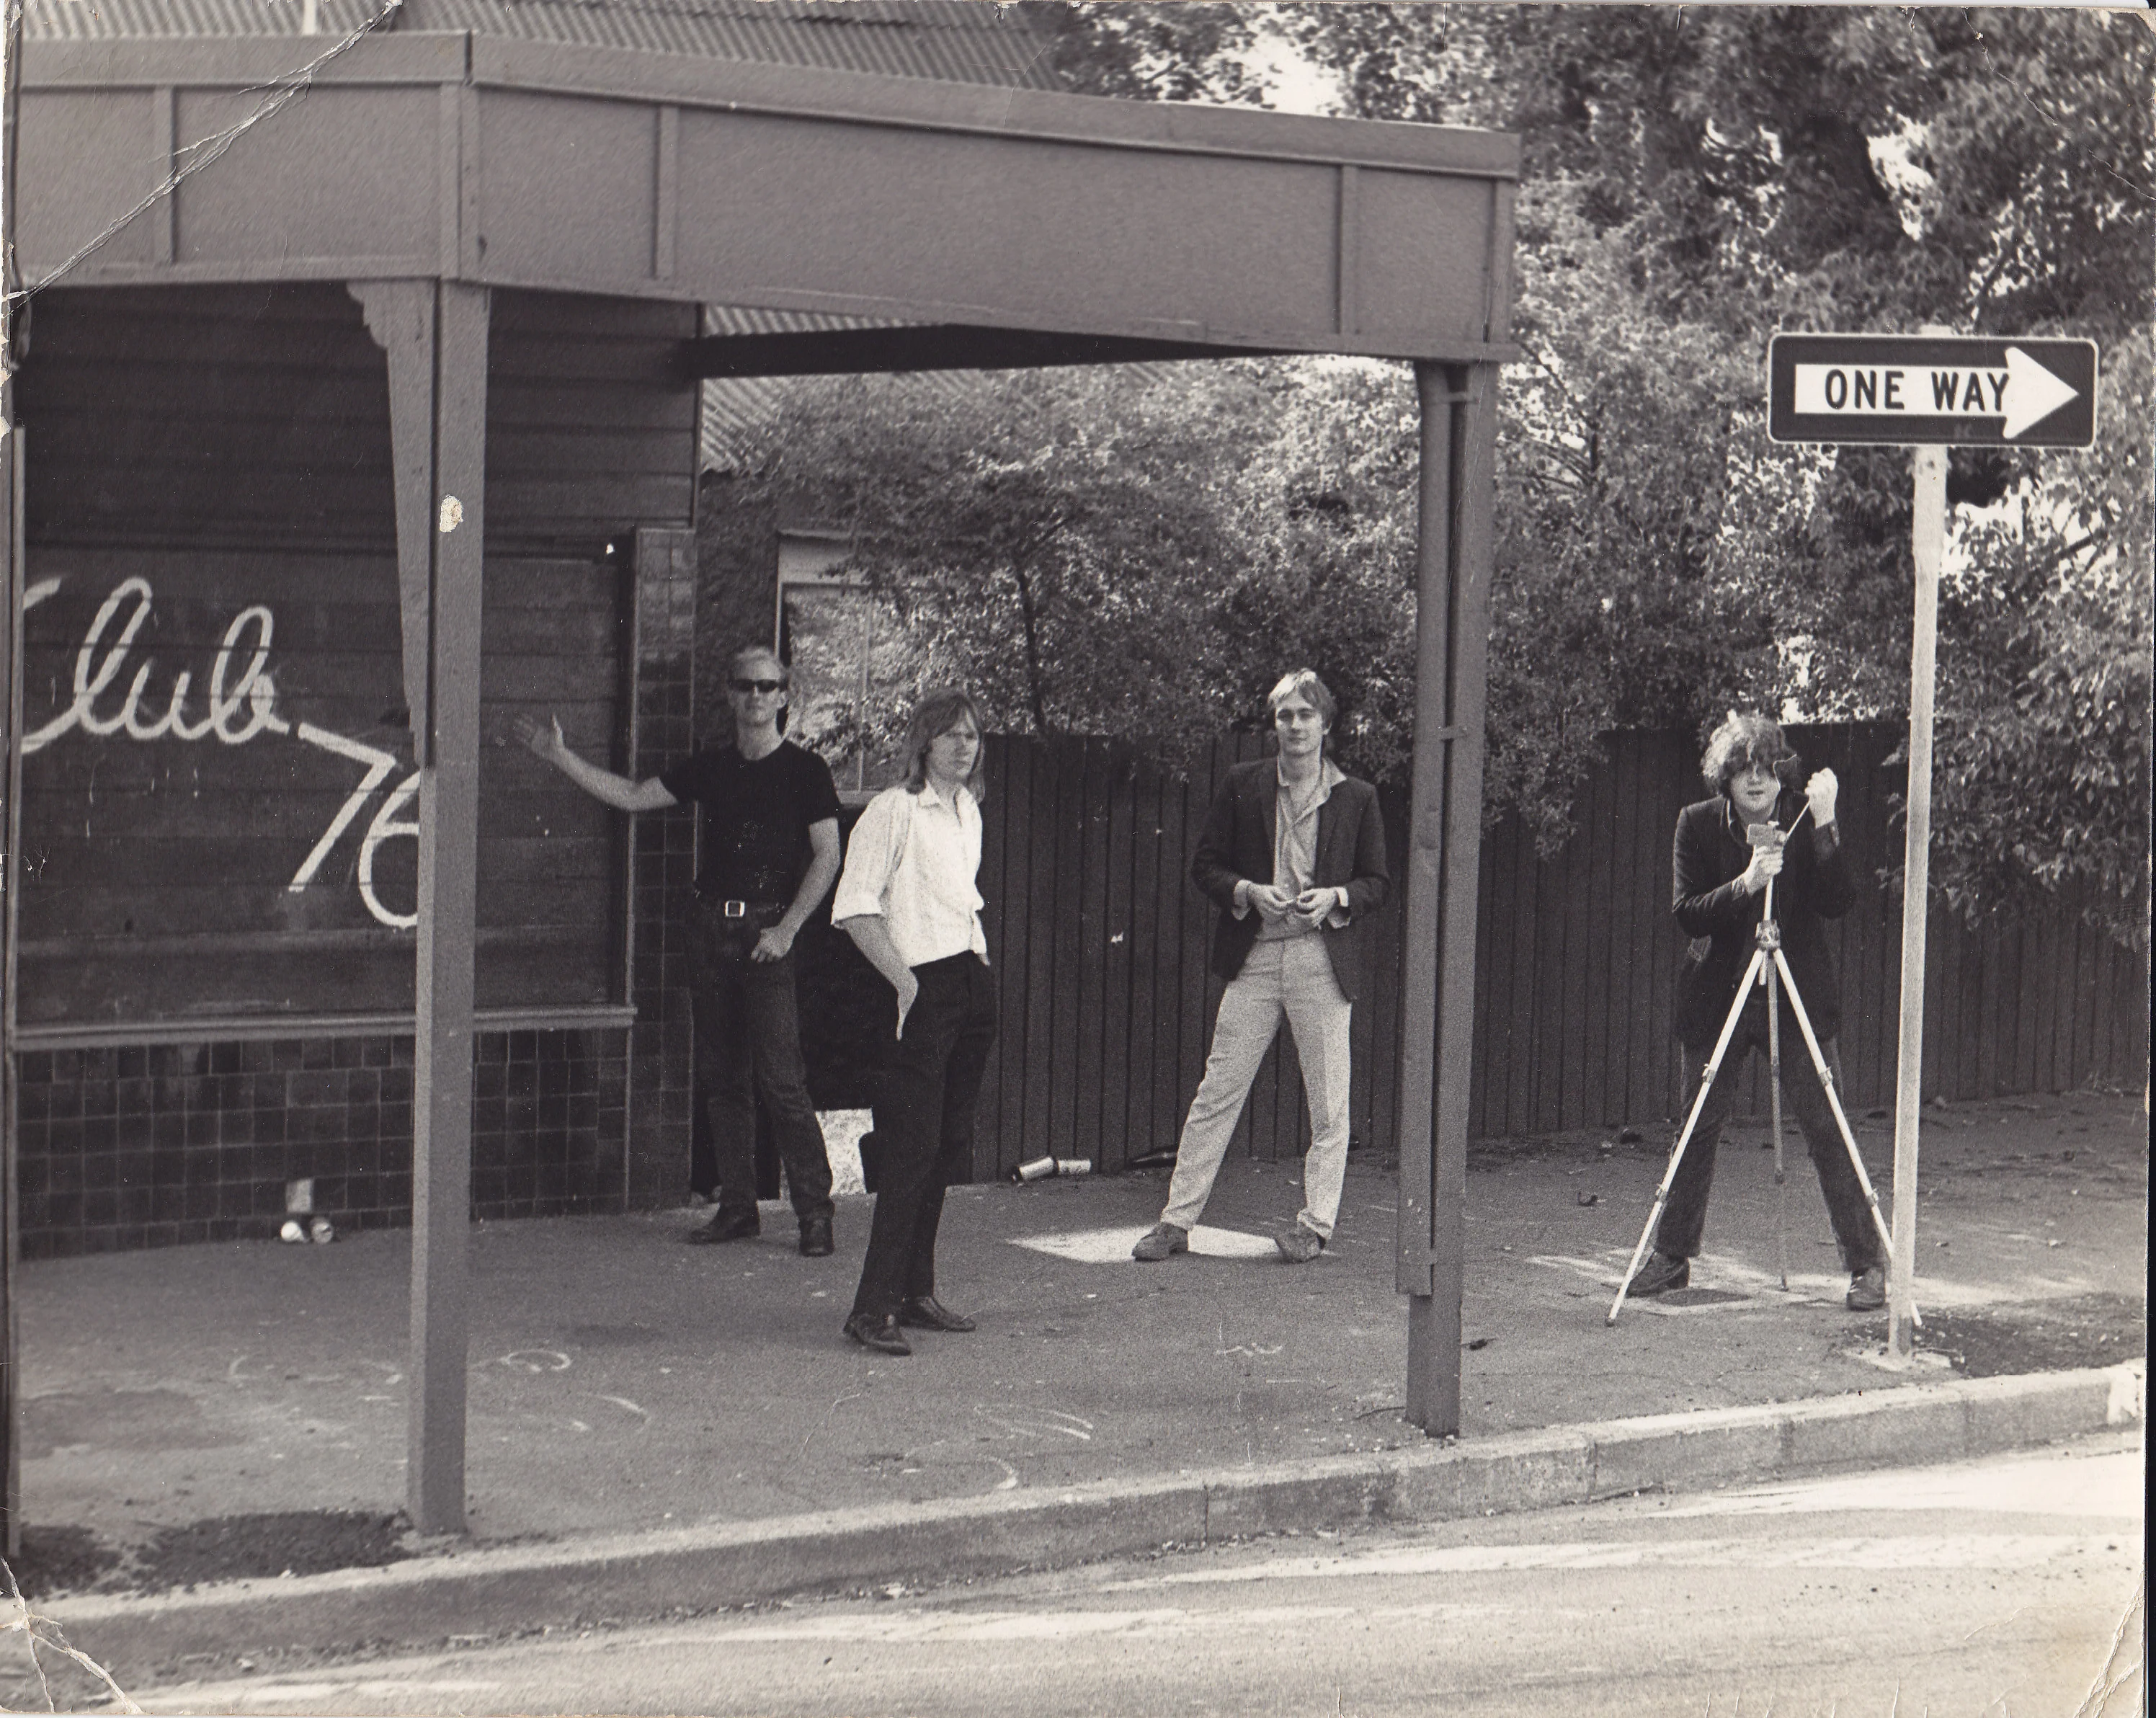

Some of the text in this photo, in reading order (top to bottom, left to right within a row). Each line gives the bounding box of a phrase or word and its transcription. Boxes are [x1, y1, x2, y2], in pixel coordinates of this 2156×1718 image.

[1825, 369, 2010, 412] ONE WAY
[289, 723, 420, 930] 76
